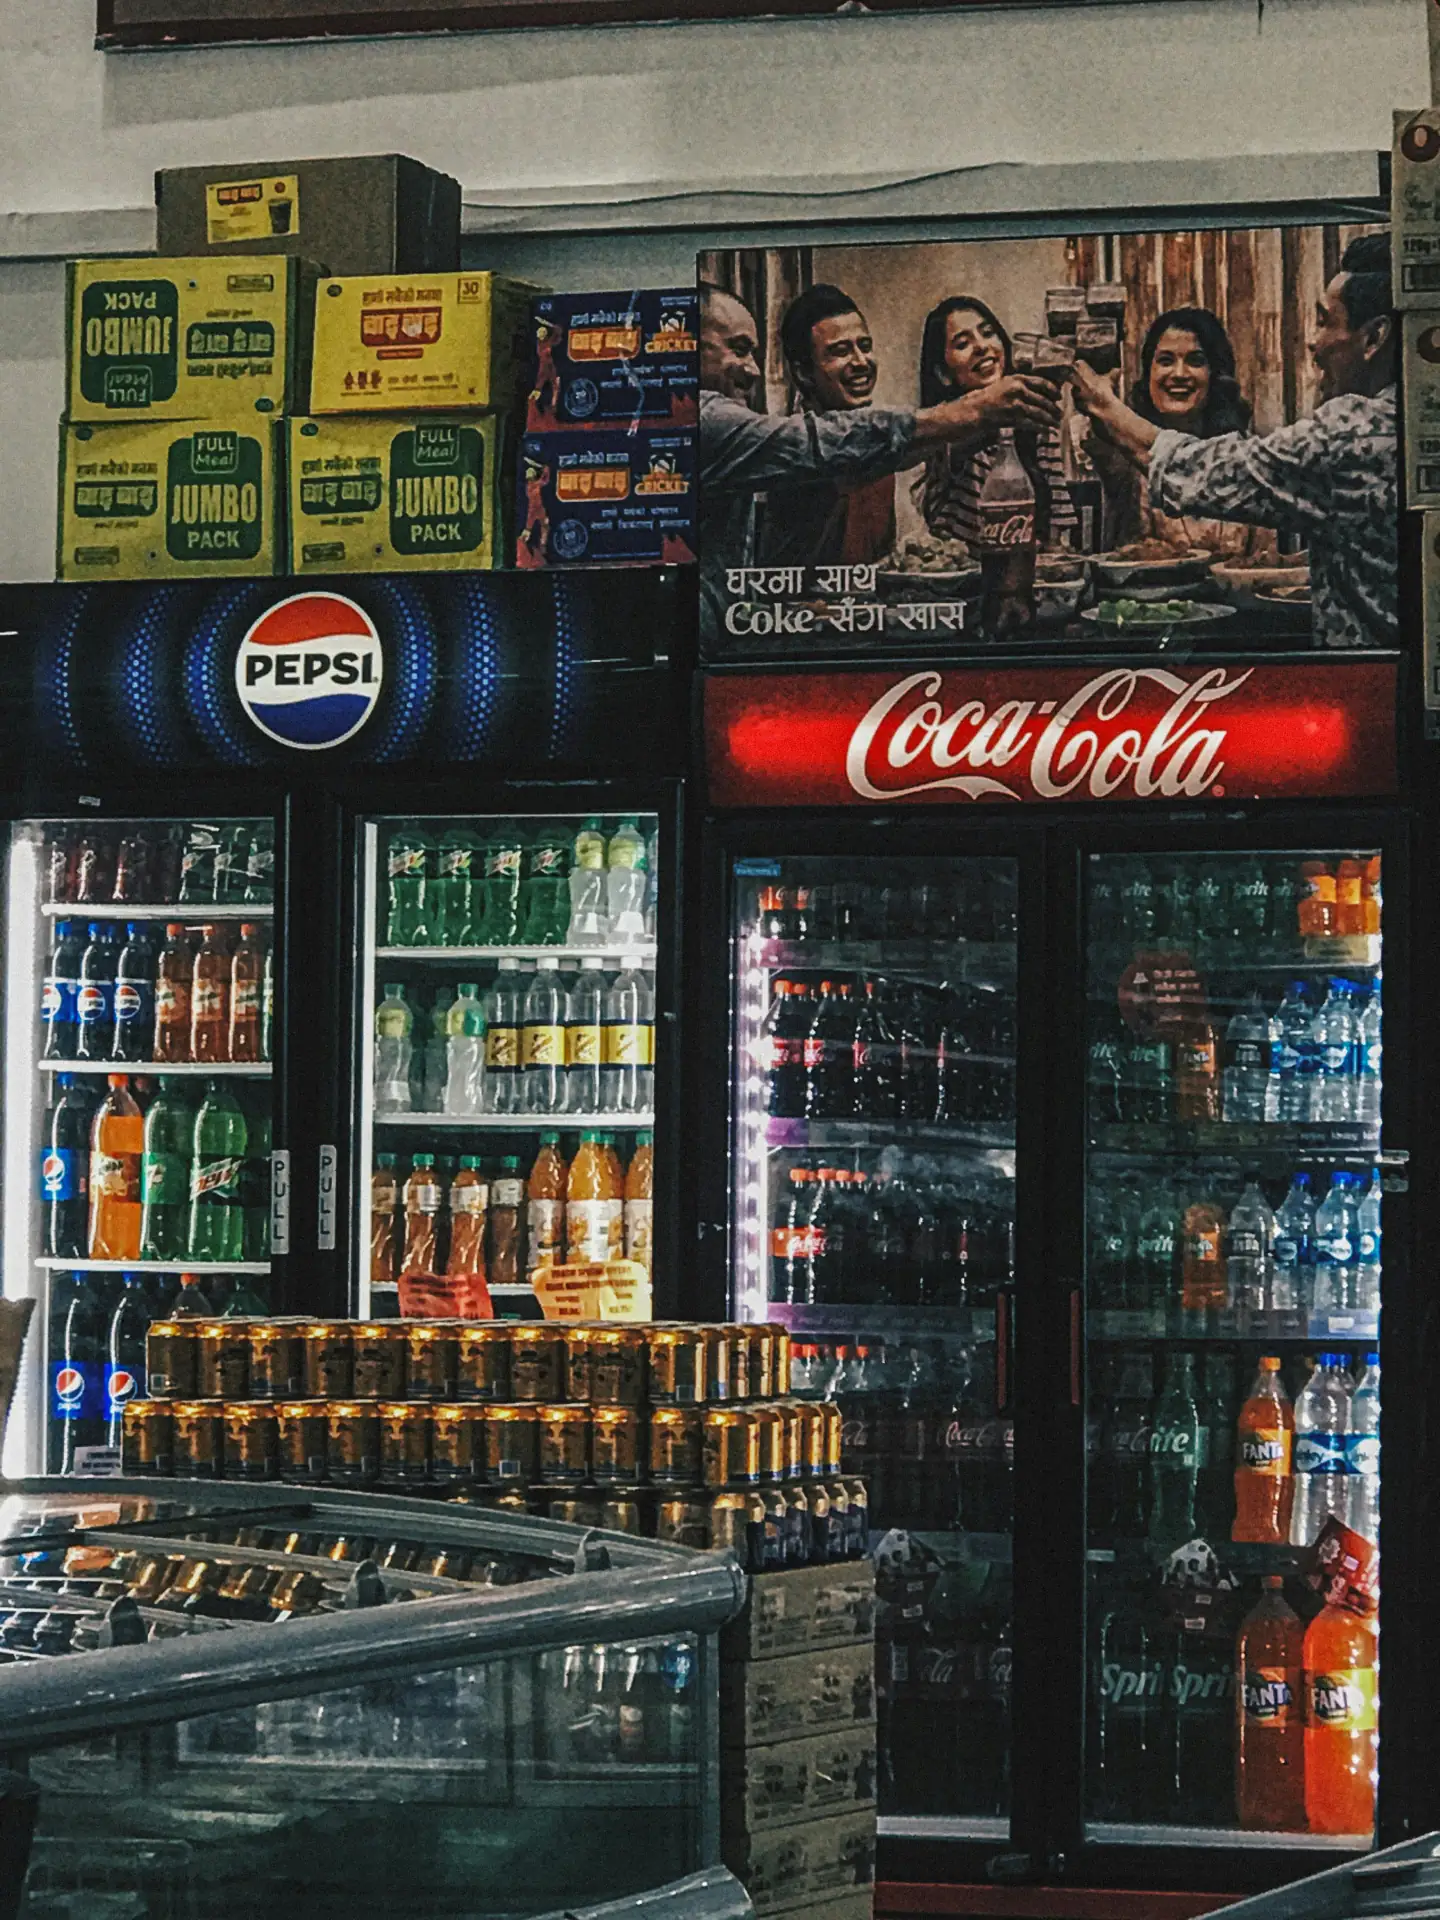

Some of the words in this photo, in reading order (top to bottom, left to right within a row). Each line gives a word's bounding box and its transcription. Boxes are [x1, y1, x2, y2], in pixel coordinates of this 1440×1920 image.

[104, 291, 157, 310] PACK
[462, 282, 479, 294] 30
[86, 316, 172, 356] JUMBO
[108, 373, 148, 387] Meal
[108, 388, 147, 402] FULL
[197, 436, 235, 451] FULL
[419, 429, 455, 443] FULL
[195, 453, 234, 466] Meal
[416, 446, 454, 459] Meal
[171, 483, 257, 525] JUMBO
[394, 474, 477, 518] JUMBO
[187, 530, 240, 549] PACK
[410, 523, 462, 543] PACK
[726, 566, 805, 595] घरमा
[815, 564, 880, 593] साथ
[725, 602, 815, 635] Coke
[897, 601, 967, 631] खास
[246, 652, 373, 686] PEPSI
[845, 668, 1255, 801] Coca-Cola
[272, 1159, 286, 1240] PULL
[319, 1154, 333, 1236] PULL
[1150, 1426, 1189, 1453] rite
[1101, 1661, 1163, 1704] Spri
[1171, 1663, 1232, 1706] Spri
